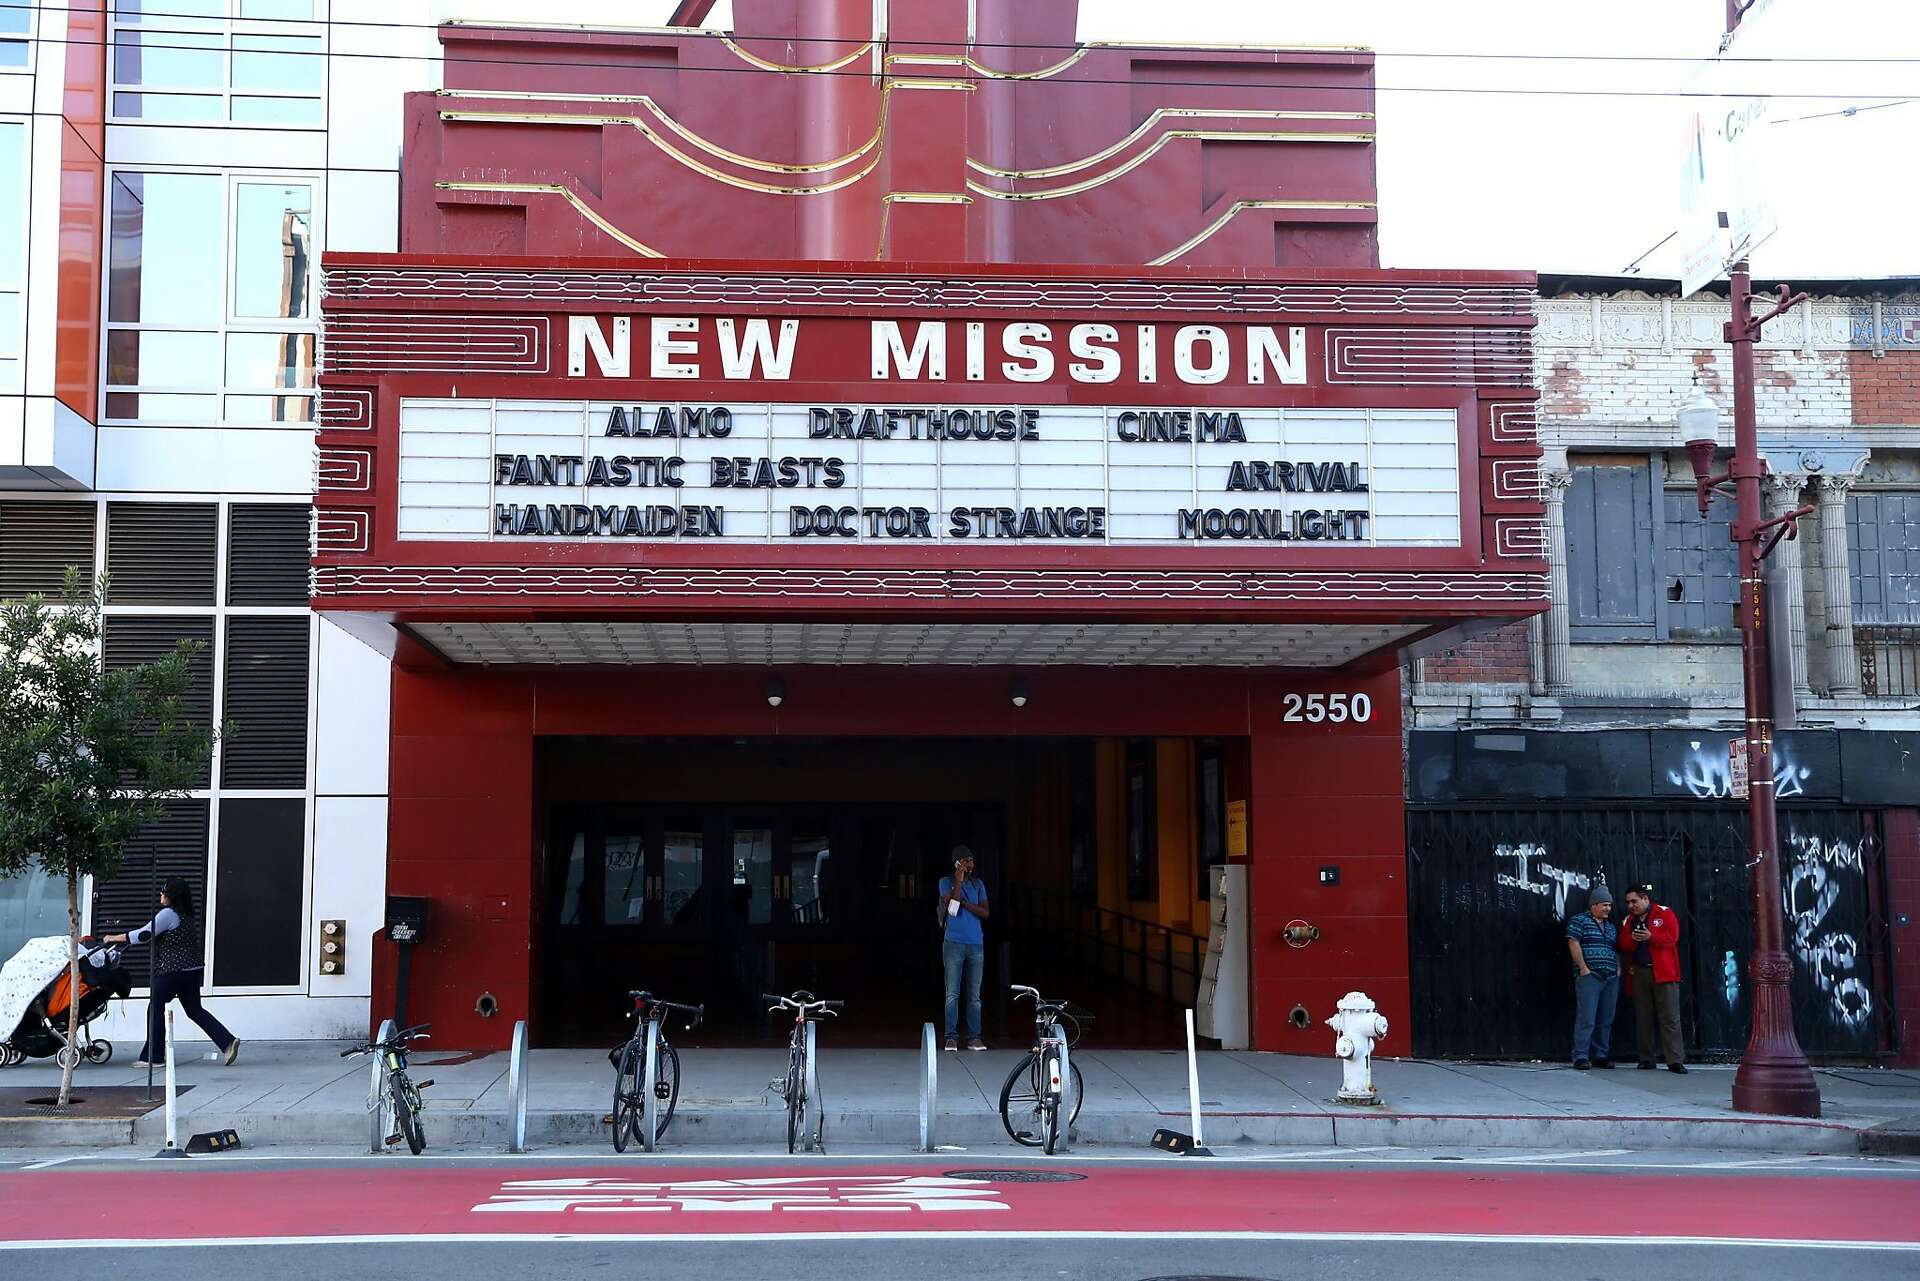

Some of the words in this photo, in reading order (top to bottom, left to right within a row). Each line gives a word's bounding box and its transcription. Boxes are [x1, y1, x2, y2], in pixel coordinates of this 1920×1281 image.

[567, 315, 800, 380] NEW
[871, 320, 1308, 385] MISSION
[605, 405, 733, 440] ALAMO
[808, 406, 1040, 442] DRAFTHOUSE
[1116, 409, 1247, 444] CINEMA
[494, 453, 686, 489] FANTASTIC
[707, 456, 845, 490] BEASTS
[1226, 460, 1370, 494] ARRIVAL
[493, 503, 727, 538] HANDMAIDEN
[789, 505, 932, 540] DOCTOR
[948, 506, 1106, 540] STRANGE
[1178, 508, 1370, 542] MOONLIGHT
[1282, 692, 1372, 723] 2550
